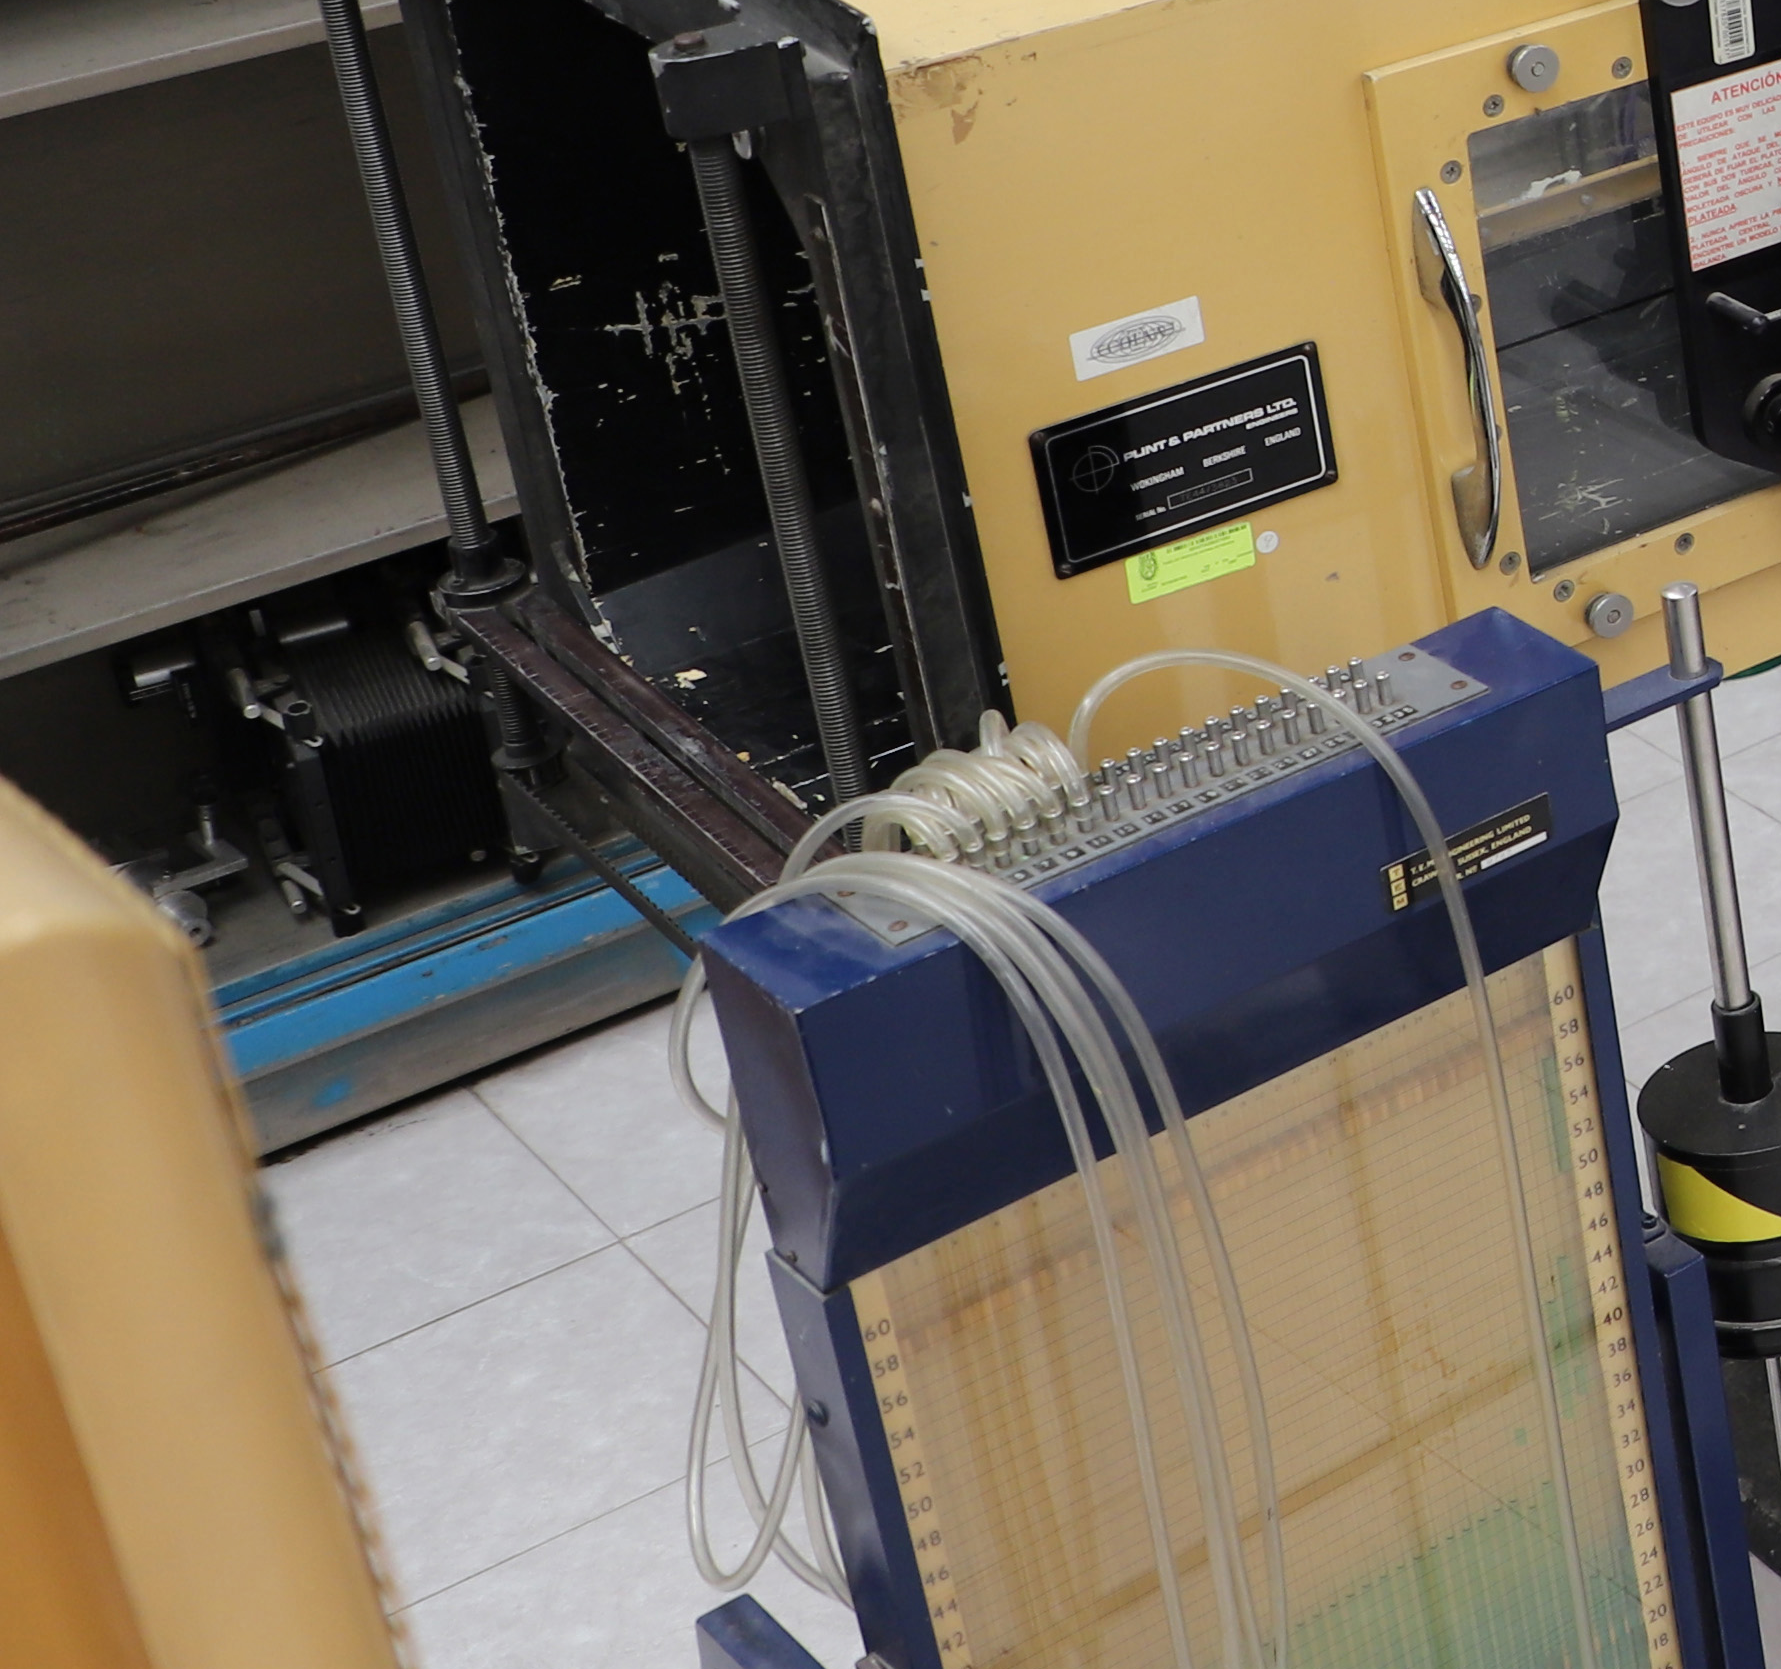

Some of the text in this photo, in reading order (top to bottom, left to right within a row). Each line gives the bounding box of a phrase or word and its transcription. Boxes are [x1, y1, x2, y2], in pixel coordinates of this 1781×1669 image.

[1124, 398, 1296, 462] PLINT & PARTNERS LTD.
[1130, 427, 1301, 491] WOKINGHAM BERKSHIRE ENGLAND
[1497, 814, 1531, 835] LIMITED
[1491, 826, 1532, 850] ENGLAND
[1553, 985, 1575, 1005] 60
[1558, 1019, 1580, 1039] 58
[1563, 1053, 1585, 1073] 56
[1569, 1085, 1589, 1105] 54
[1573, 1118, 1595, 1138] 52
[1578, 1148, 1599, 1170] 50
[1584, 1181, 1604, 1200] 48
[1587, 1210, 1609, 1231] 46
[1592, 1245, 1613, 1263] 44
[1598, 1276, 1619, 1295] 42
[1603, 1307, 1623, 1326] 40
[864, 1319, 891, 1343] 60
[1607, 1337, 1626, 1358] 38
[874, 1354, 900, 1379] 58
[1612, 1368, 1632, 1388] 36
[882, 1393, 908, 1415] 56
[1617, 1398, 1637, 1419] 34
[890, 1427, 915, 1450] 54
[1621, 1429, 1641, 1449] 32
[900, 1462, 925, 1486] 52
[1625, 1458, 1645, 1479] 30
[907, 1495, 933, 1519] 50
[1630, 1487, 1649, 1509] 28
[1635, 1518, 1655, 1538] 26
[916, 1531, 942, 1553] 48
[1639, 1546, 1659, 1567] 24
[924, 1567, 950, 1587] 46
[1643, 1575, 1664, 1596] 22
[932, 1598, 959, 1620] 44
[1649, 1603, 1668, 1624] 20
[941, 1631, 967, 1654] 42
[1653, 1633, 1669, 1650] 18
